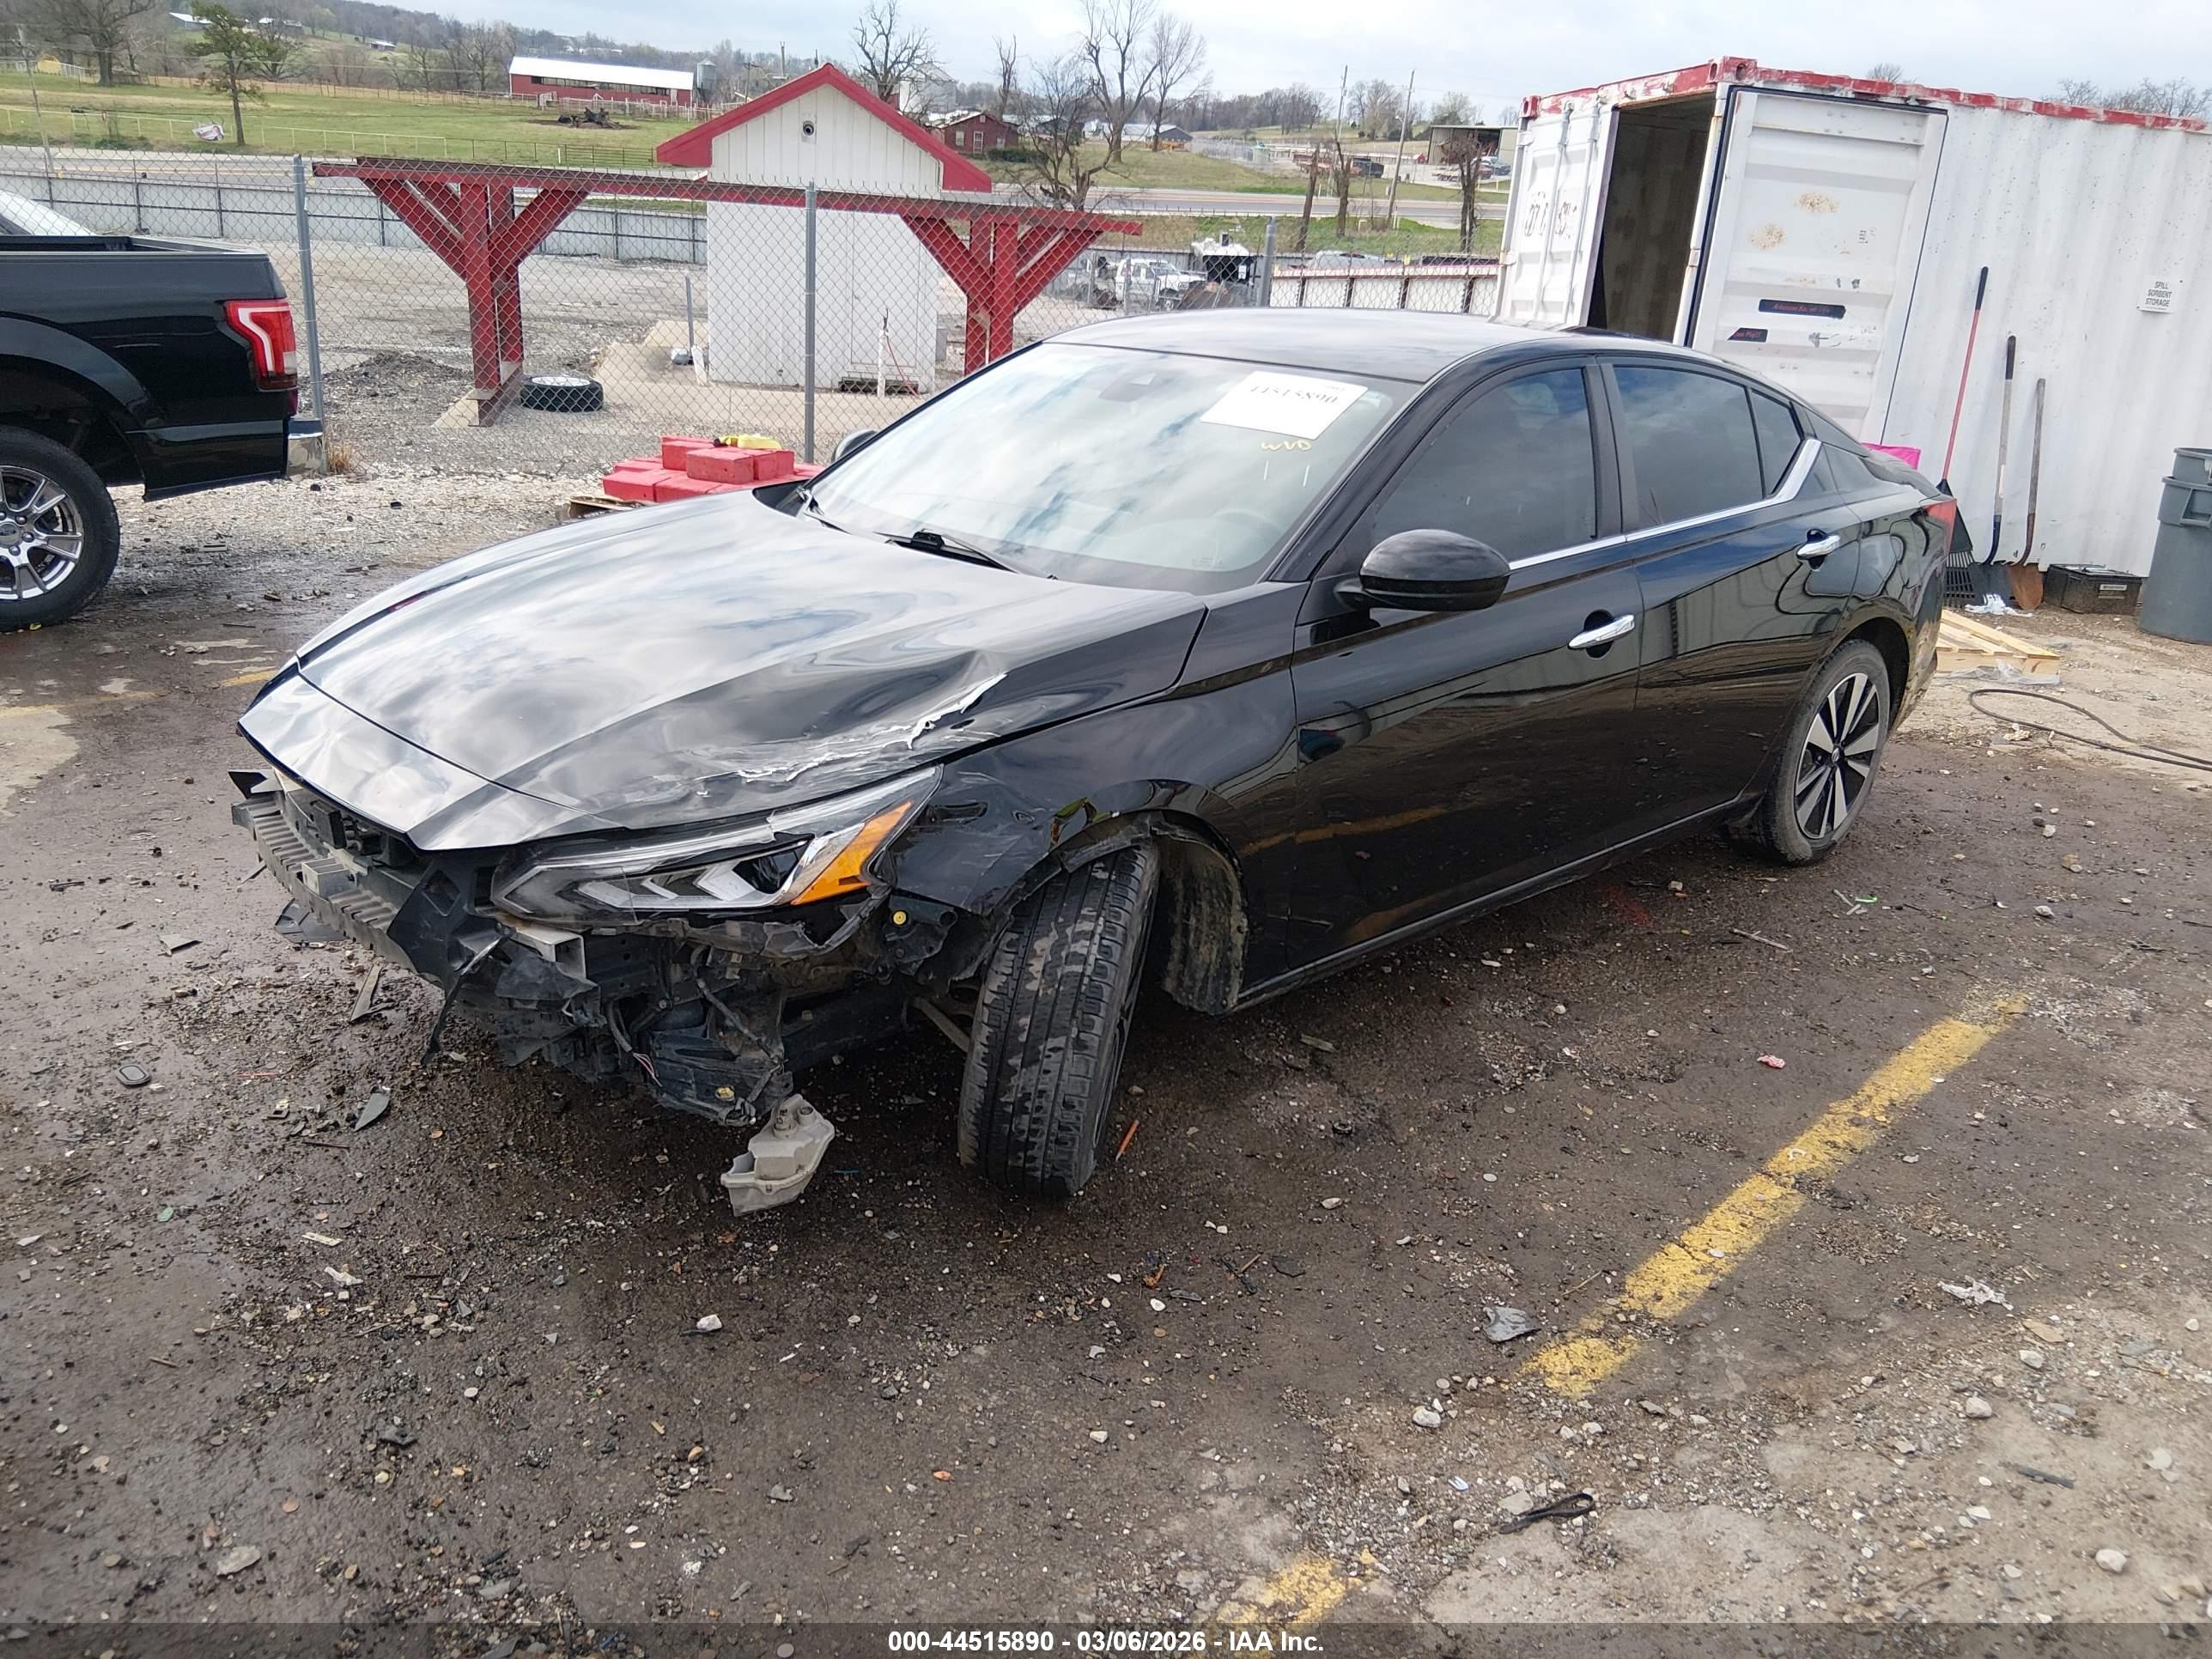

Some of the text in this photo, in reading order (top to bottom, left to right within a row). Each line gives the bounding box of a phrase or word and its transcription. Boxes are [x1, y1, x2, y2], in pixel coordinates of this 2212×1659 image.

[2154, 281, 2169, 289] SPILL
[2148, 289, 2172, 298] SORBENT
[2145, 297, 2171, 307] STORAGE
